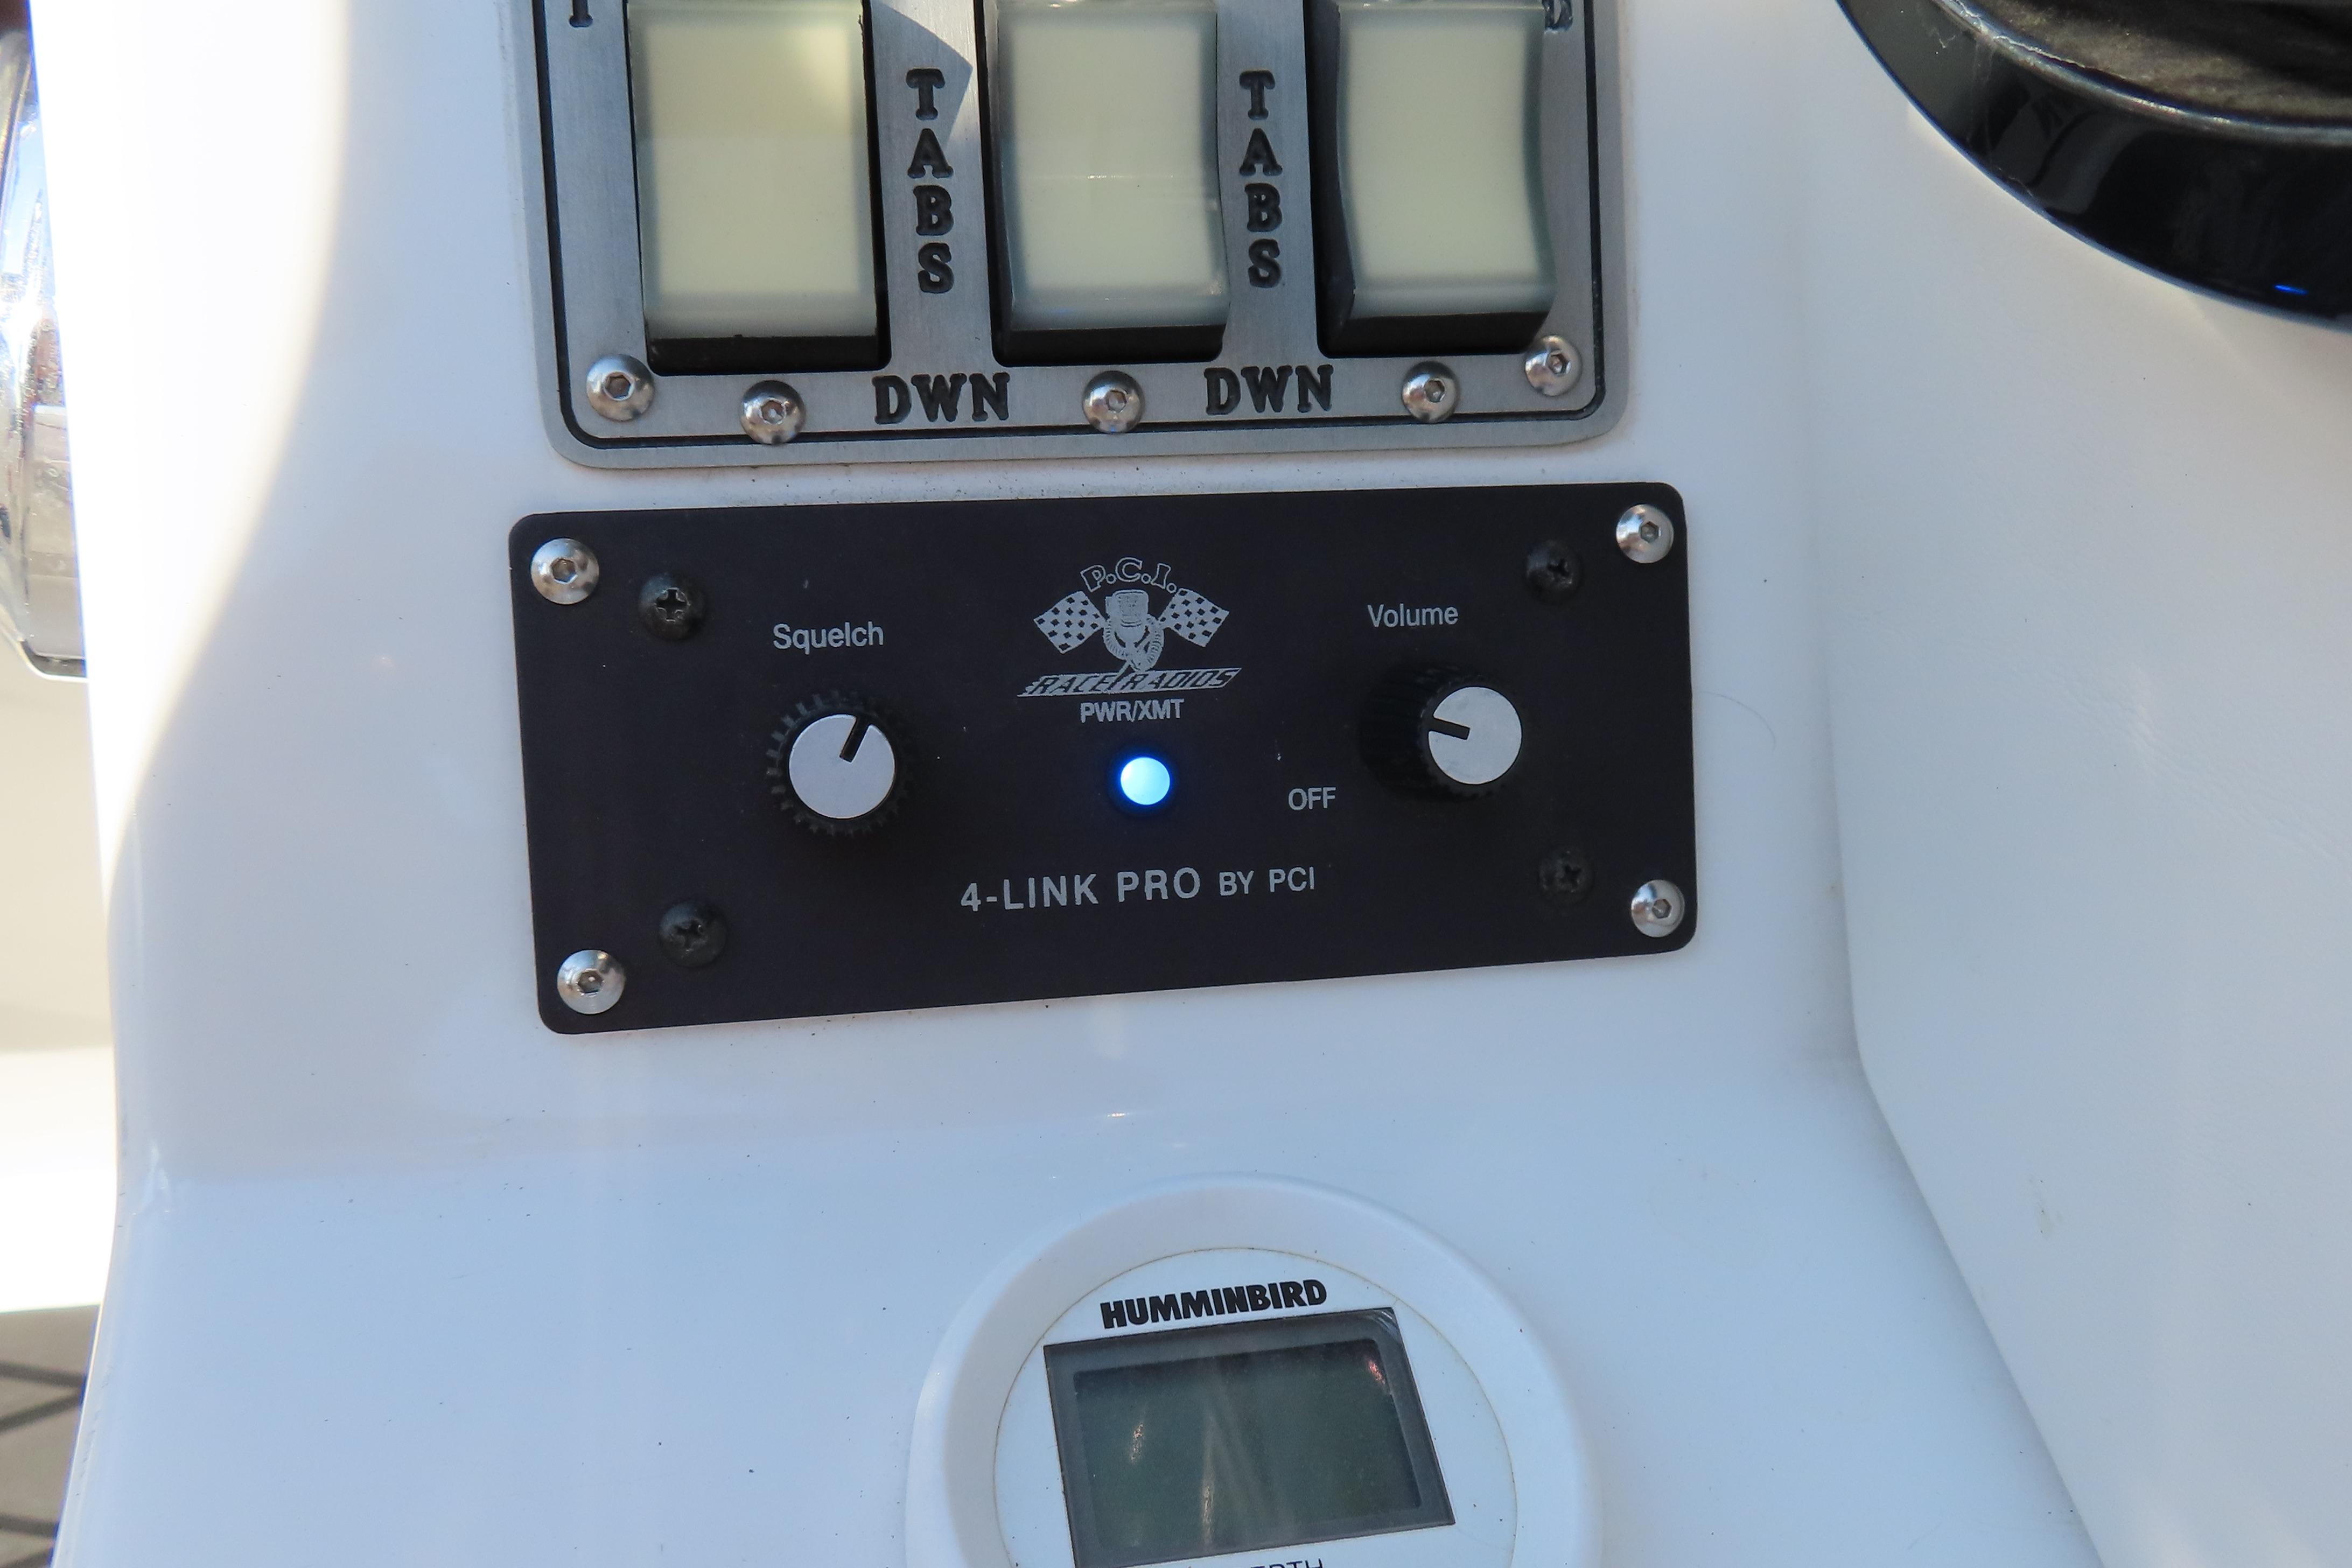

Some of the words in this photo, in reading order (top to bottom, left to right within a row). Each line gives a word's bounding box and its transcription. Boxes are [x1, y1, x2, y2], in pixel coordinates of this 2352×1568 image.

[906, 68, 954, 293] TABS
[1239, 70, 1283, 289] TABS
[872, 372, 1010, 424] DWN
[1204, 365, 1333, 415] DWN
[1080, 557, 1177, 593] P.C.I.
[1367, 603, 1459, 627] Volume
[773, 621, 884, 655] Squelch
[1080, 699, 1185, 723] PWR/XMT
[1288, 787, 1336, 811] OFF
[961, 873, 1099, 911] 4-LINK
[1117, 866, 1200, 902] PRO
[1219, 870, 1254, 896] BY
[1269, 866, 1315, 892] PCI
[1100, 1279, 1327, 1328] HUMMINBIRD
